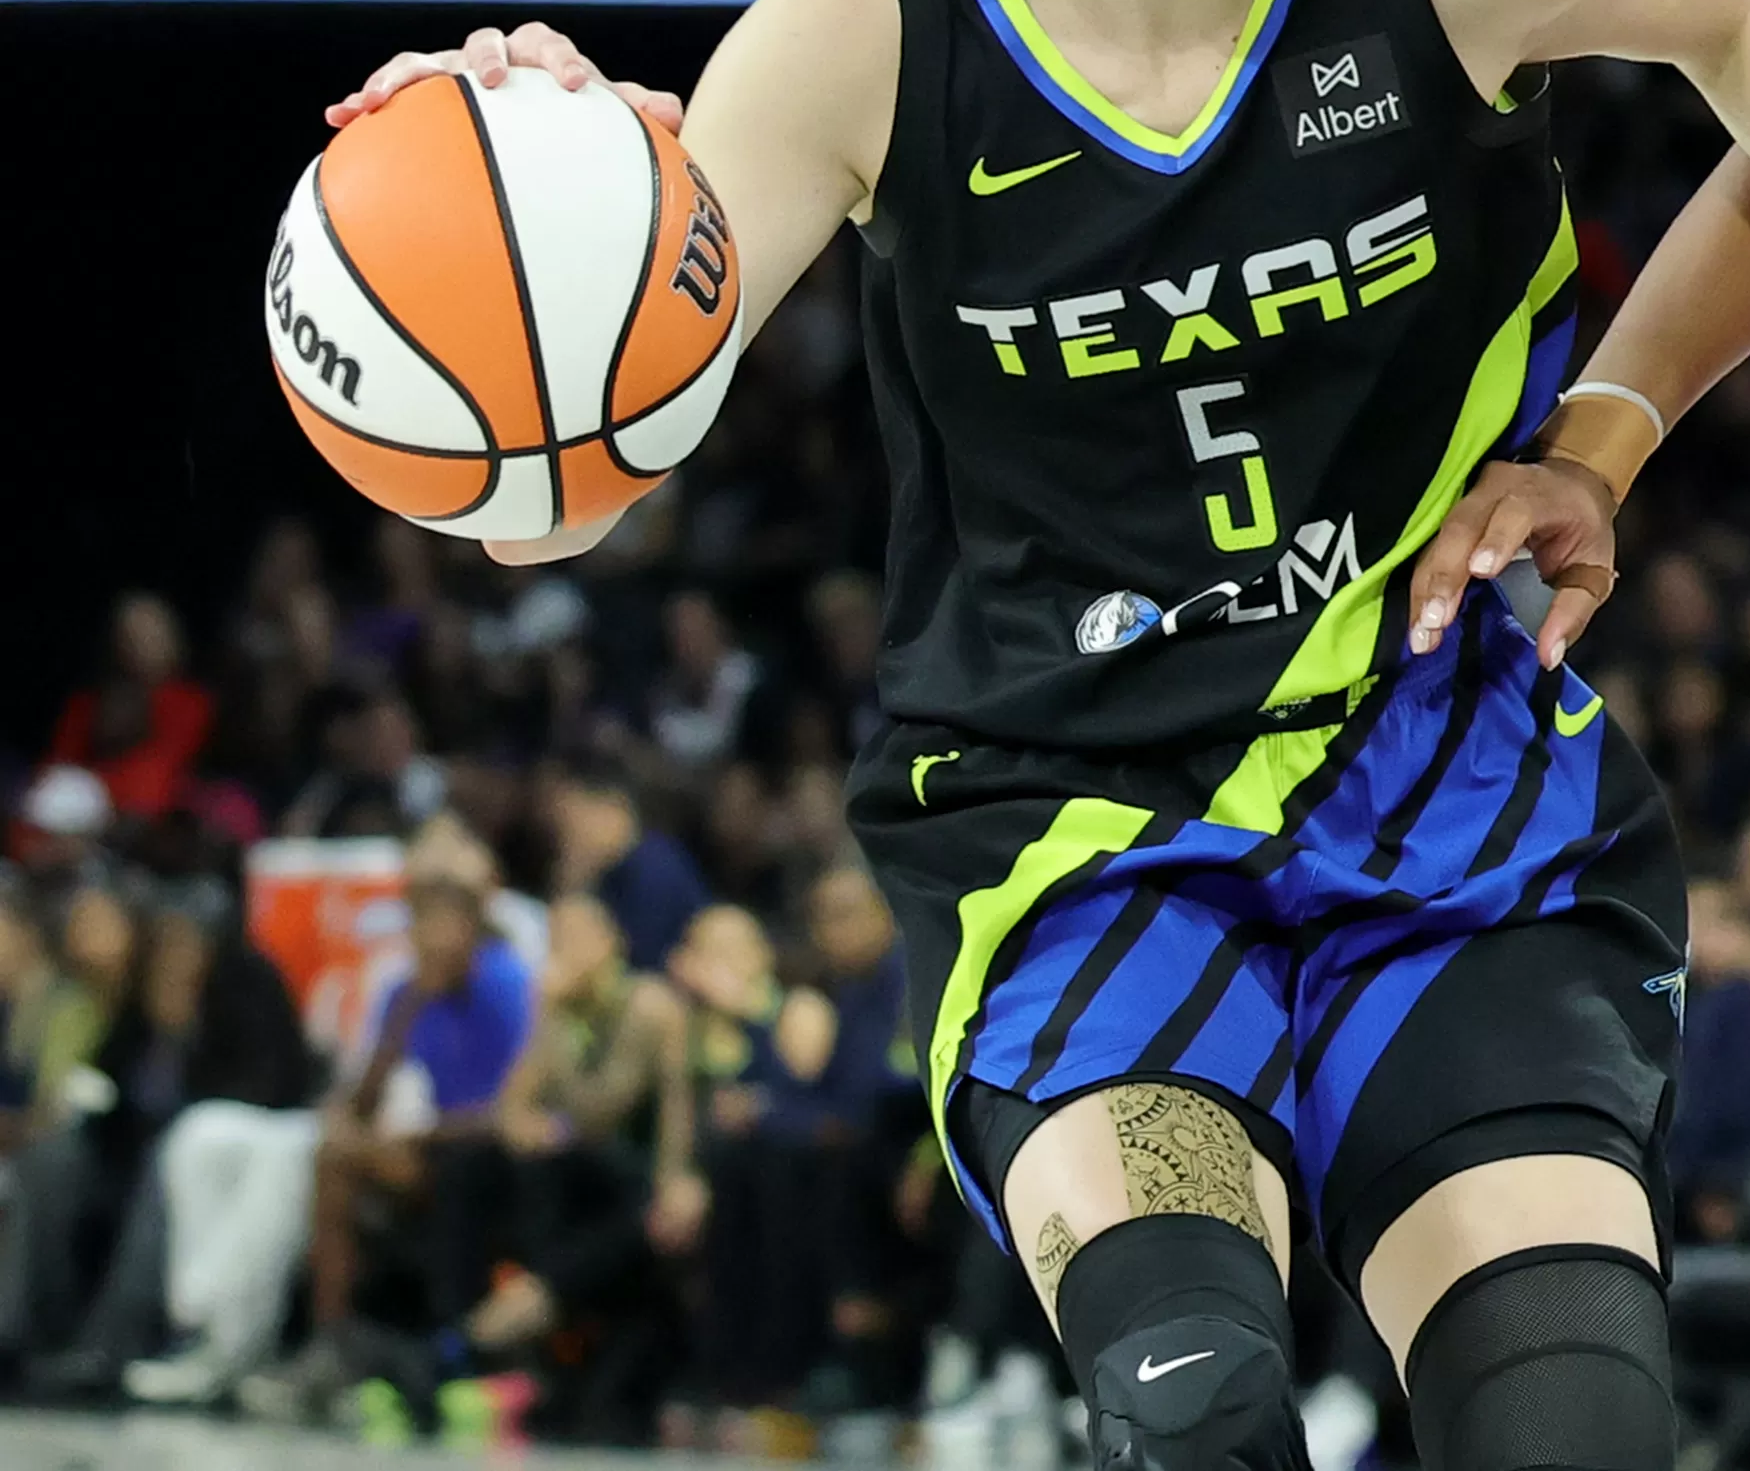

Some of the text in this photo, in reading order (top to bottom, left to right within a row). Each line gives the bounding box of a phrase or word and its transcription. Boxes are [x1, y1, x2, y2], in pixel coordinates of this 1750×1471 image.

[1294, 91, 1401, 148] Albert
[955, 194, 1437, 379] TEXAS
[1175, 380, 1279, 553] 5
